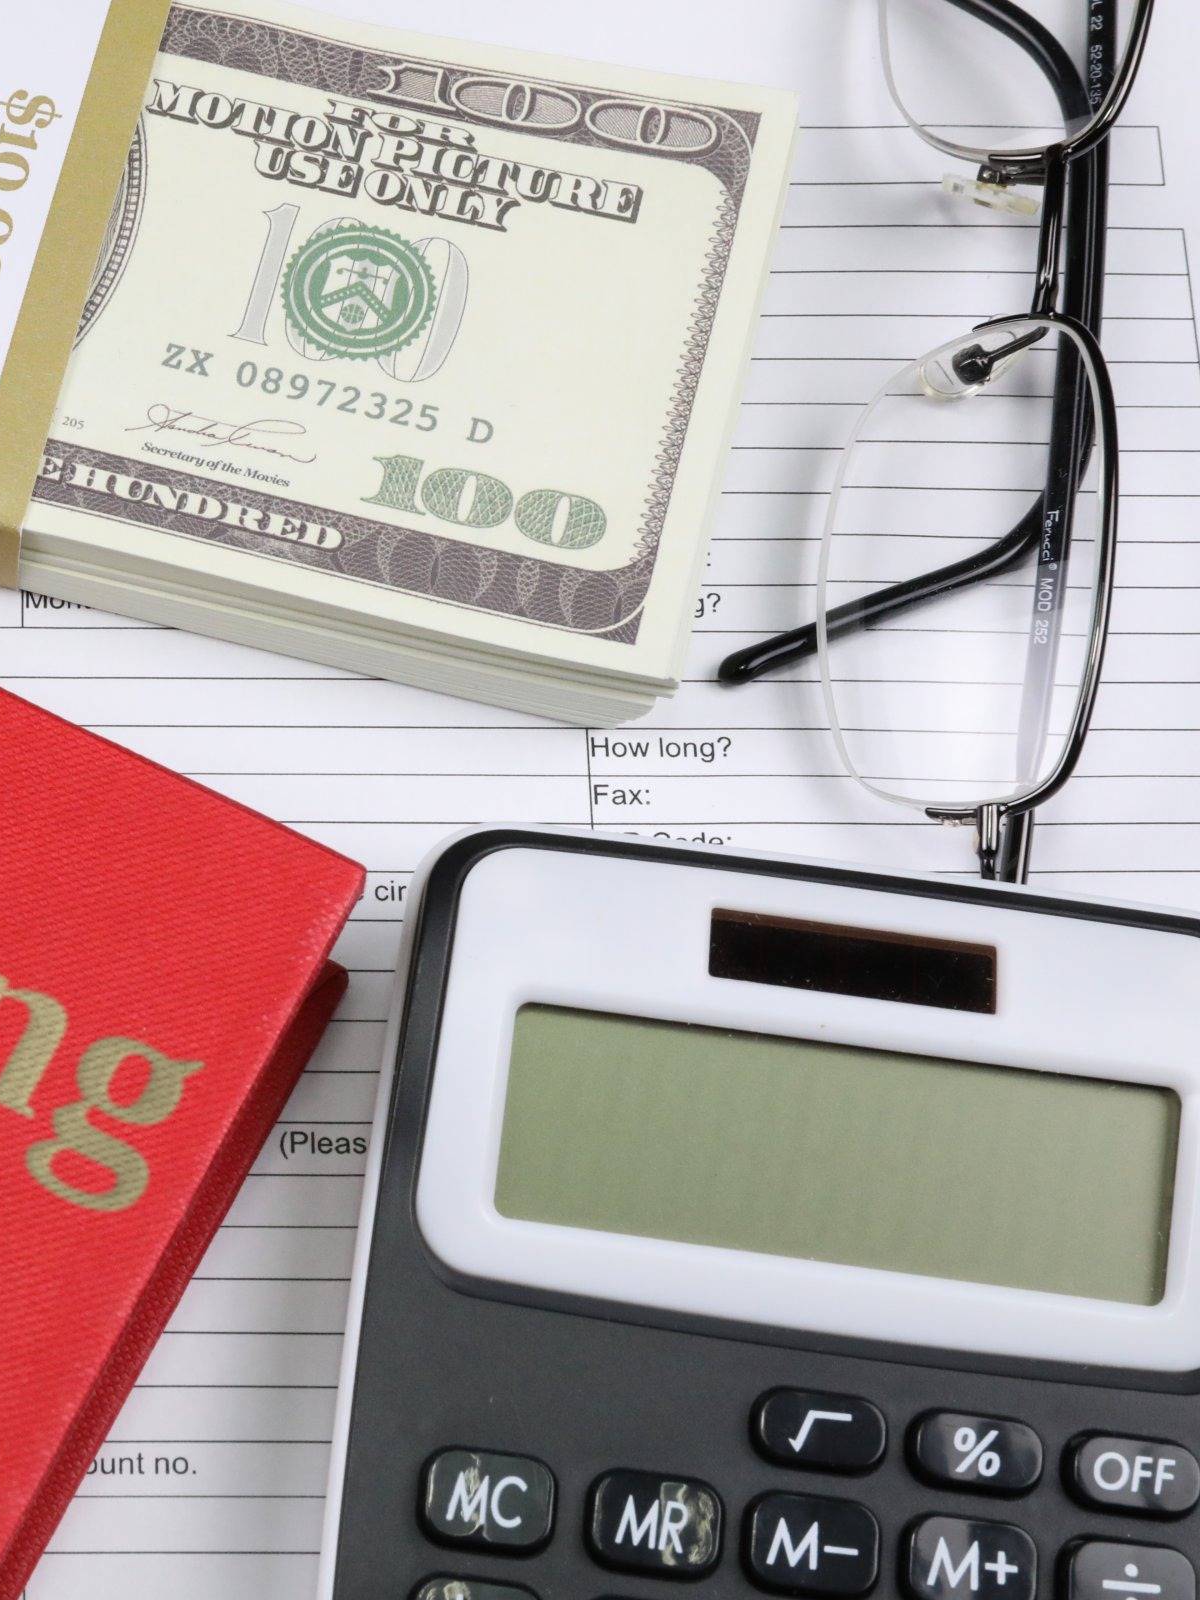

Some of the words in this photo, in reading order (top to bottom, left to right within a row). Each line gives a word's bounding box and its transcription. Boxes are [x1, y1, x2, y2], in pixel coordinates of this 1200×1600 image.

[324, 99, 478, 152] FOR
[365, 62, 722, 157] 100
[146, 79, 373, 163] MOTION
[371, 132, 644, 224] PICTURE
[254, 139, 364, 198] USE
[364, 169, 521, 232] ONLY
[161, 343, 215, 377] ZX
[236, 361, 440, 432] 08972325
[466, 416, 495, 444] D
[62, 416, 85, 430] 205
[141, 441, 208, 468] Secretary
[206, 459, 223, 471] of
[221, 462, 242, 475] the
[243, 469, 291, 487] Movies
[73, 462, 344, 549] HUNDRED
[360, 454, 607, 549] 100
[1038, 578, 1054, 612] MOD
[1033, 619, 1049, 645] 252
[590, 737, 650, 758] How
[659, 736, 732, 763] long?
[593, 784, 651, 805] Fax:
[155, 1455, 197, 1475] no.
[1093, 1451, 1176, 1495] OFF
[445, 1471, 528, 1529] MC
[614, 1494, 689, 1554] MR
[766, 1517, 859, 1571] M-
[927, 1536, 1019, 1591] M+
